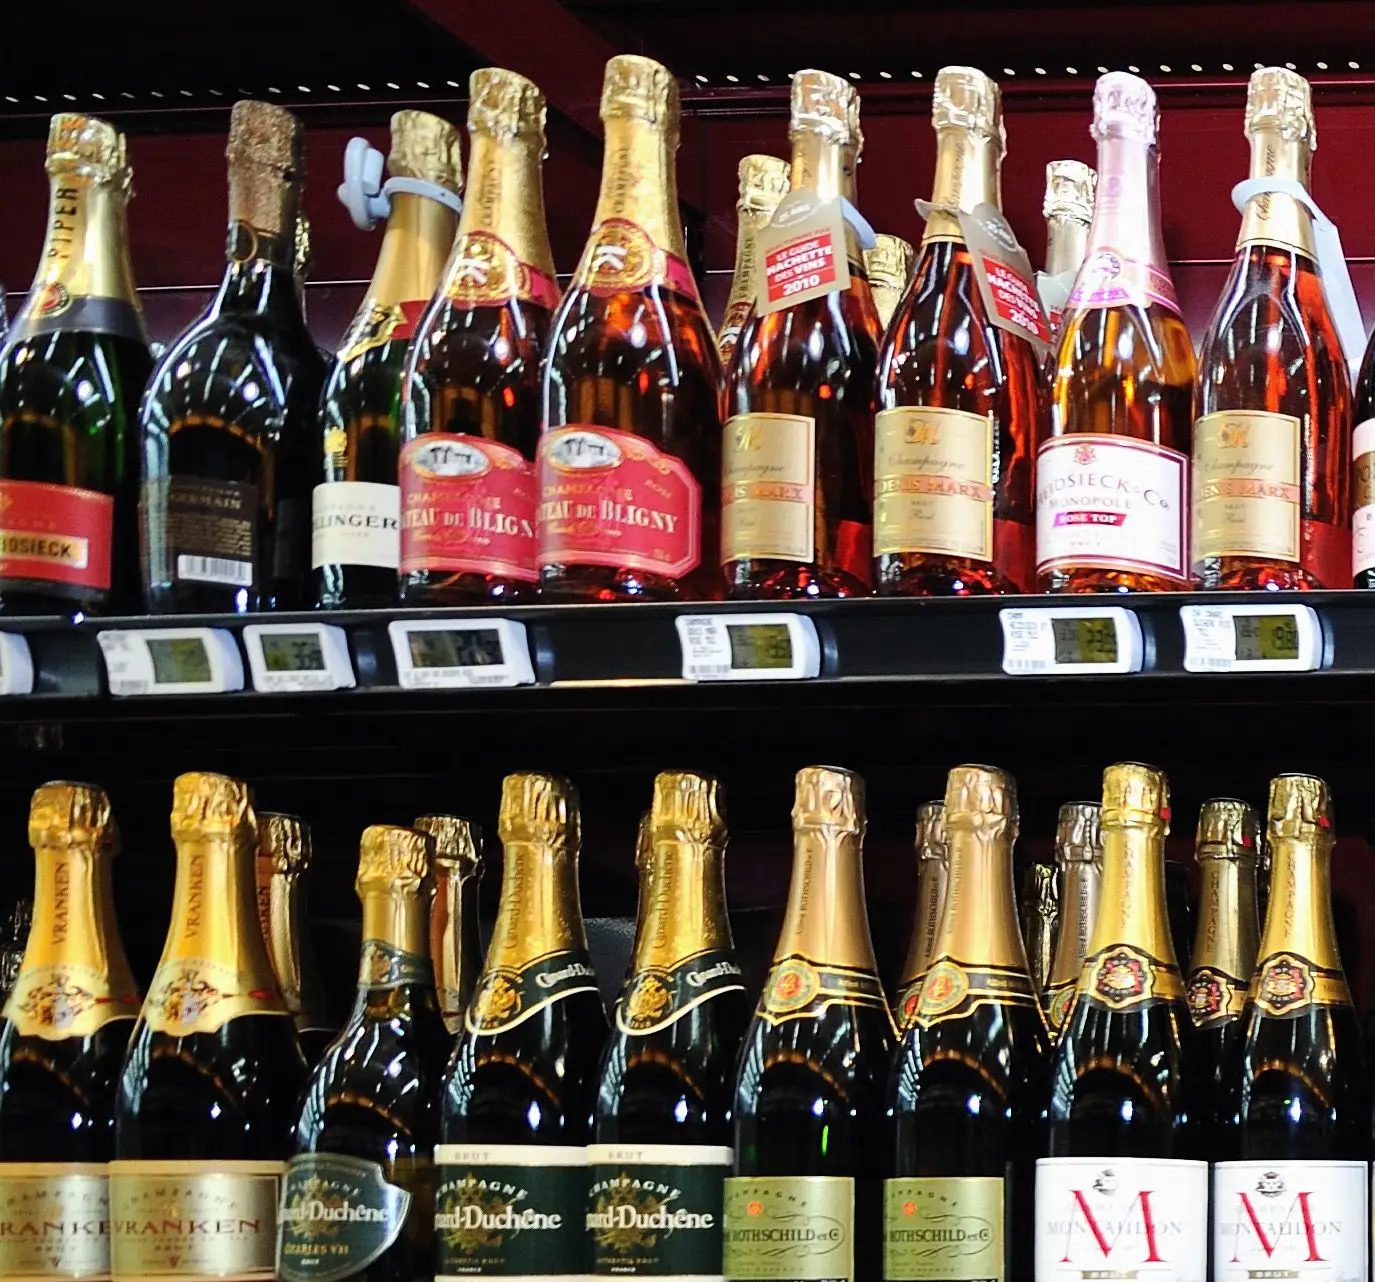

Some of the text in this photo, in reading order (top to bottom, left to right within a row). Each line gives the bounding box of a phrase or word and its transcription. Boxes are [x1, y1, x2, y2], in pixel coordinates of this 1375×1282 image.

[783, 274, 821, 296] 2010
[576, 499, 678, 534] DU BLIGNY
[1090, 514, 1118, 524] TOP
[52, 861, 69, 947] VRANKEN
[185, 854, 204, 939] VRANKEN
[111, 1219, 260, 1235] VRANKEN
[732, 1228, 816, 1242] ROTHSCHILD
[1059, 1190, 1167, 1262] M
